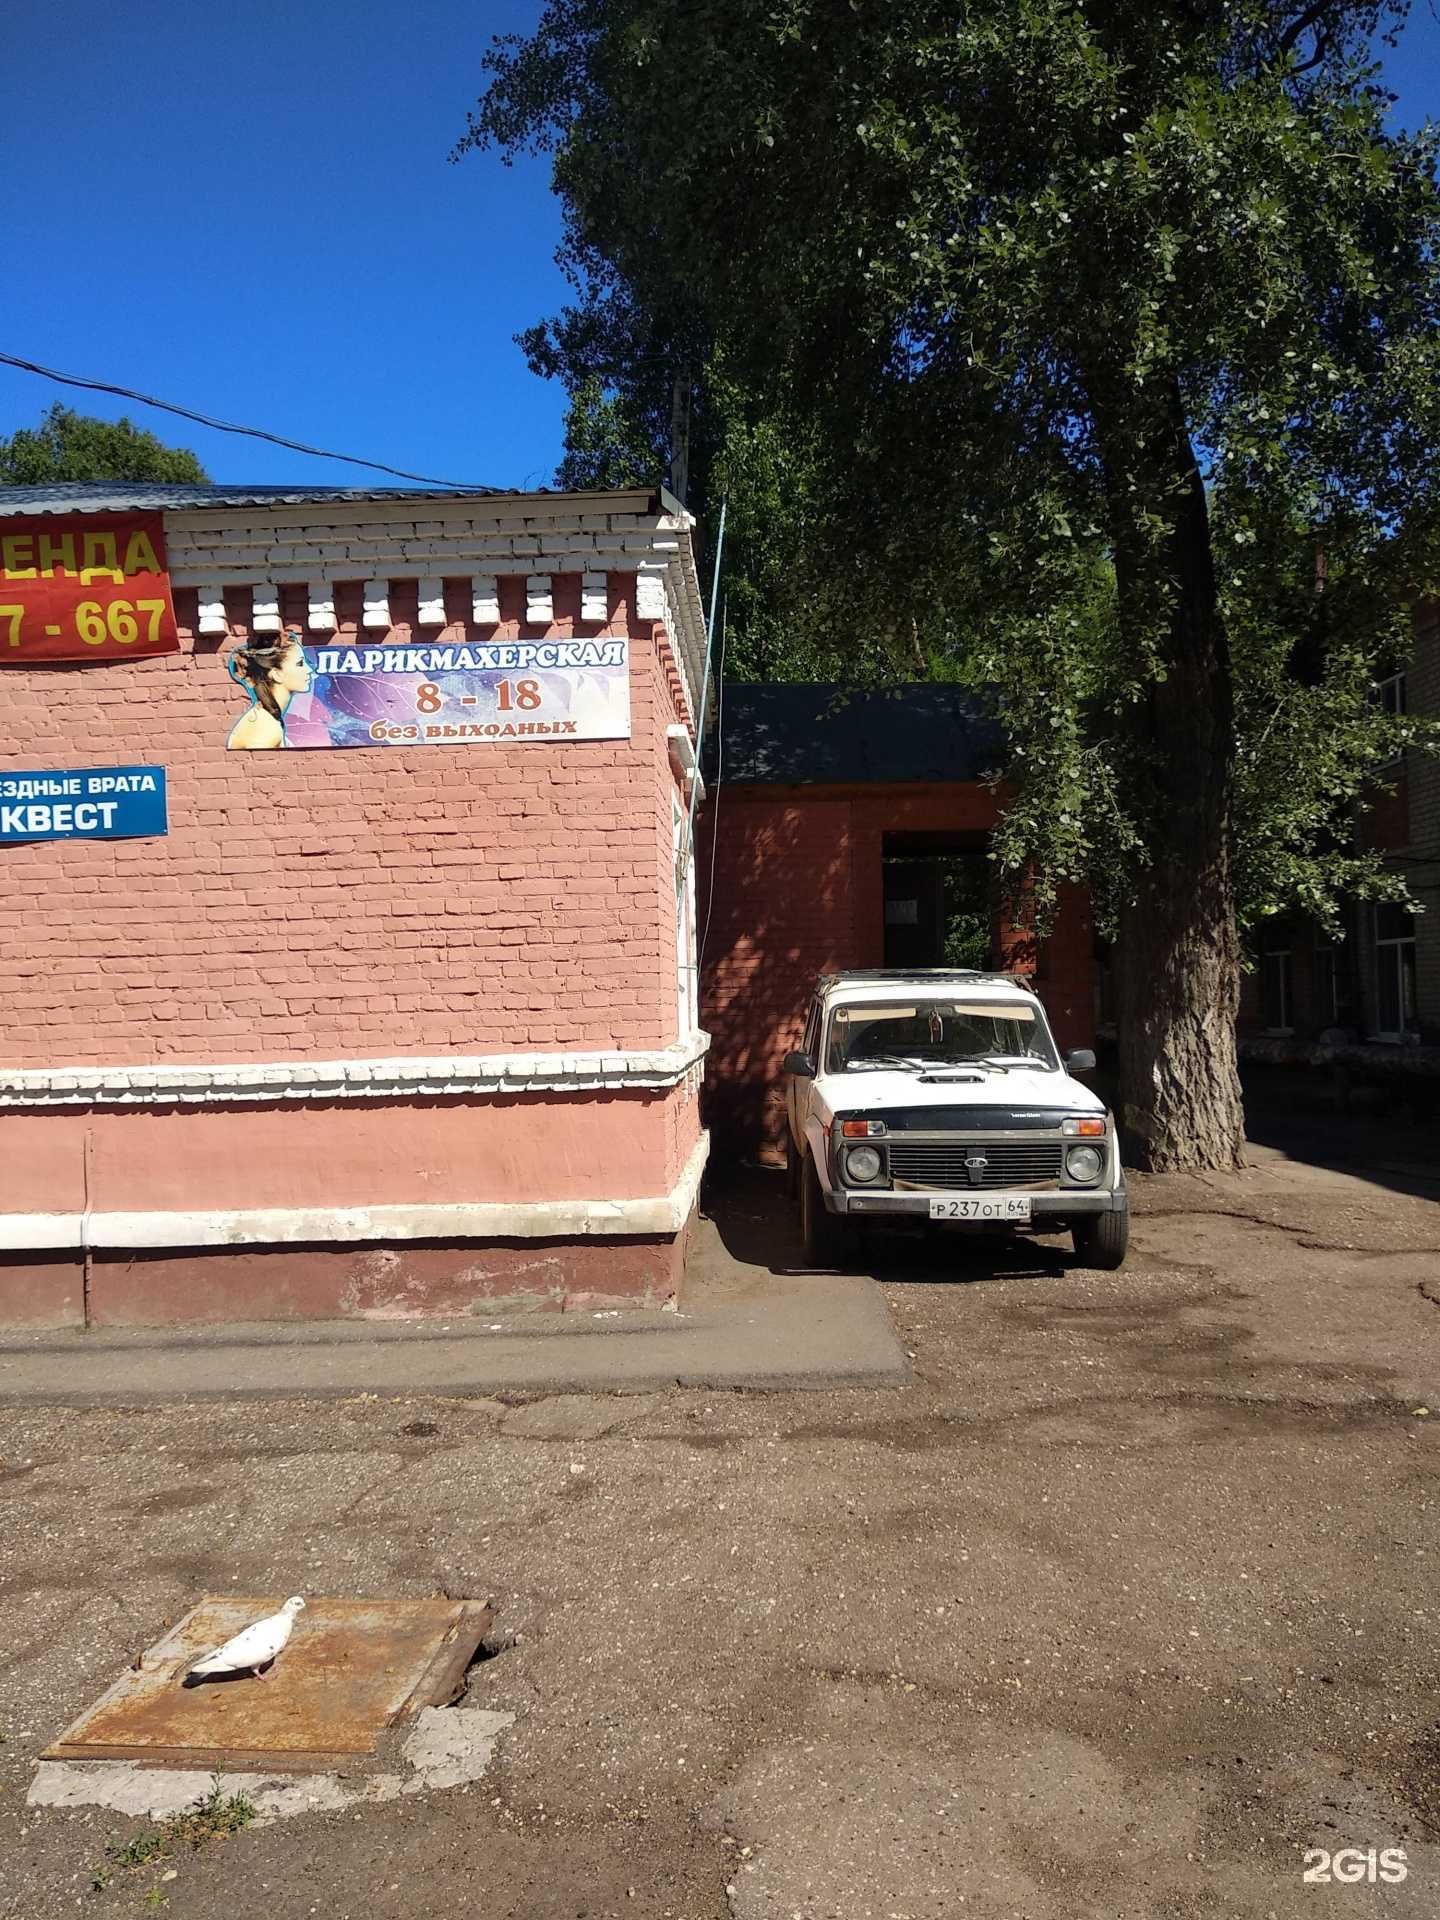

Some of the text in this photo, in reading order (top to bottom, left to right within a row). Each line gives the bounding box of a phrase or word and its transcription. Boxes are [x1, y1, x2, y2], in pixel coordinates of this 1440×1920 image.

[2, 530, 162, 586] ЕНДА
[75, 599, 166, 645] 667
[316, 642, 624, 674] ПАРИКМАХЕРСКАЯ
[416, 682, 443, 714] 8
[495, 678, 543, 711] 18
[371, 720, 577, 740] без выходных
[0, 775, 156, 799] ЗДНЫЕ ВРАТА
[1, 802, 118, 833] КВЕСТ
